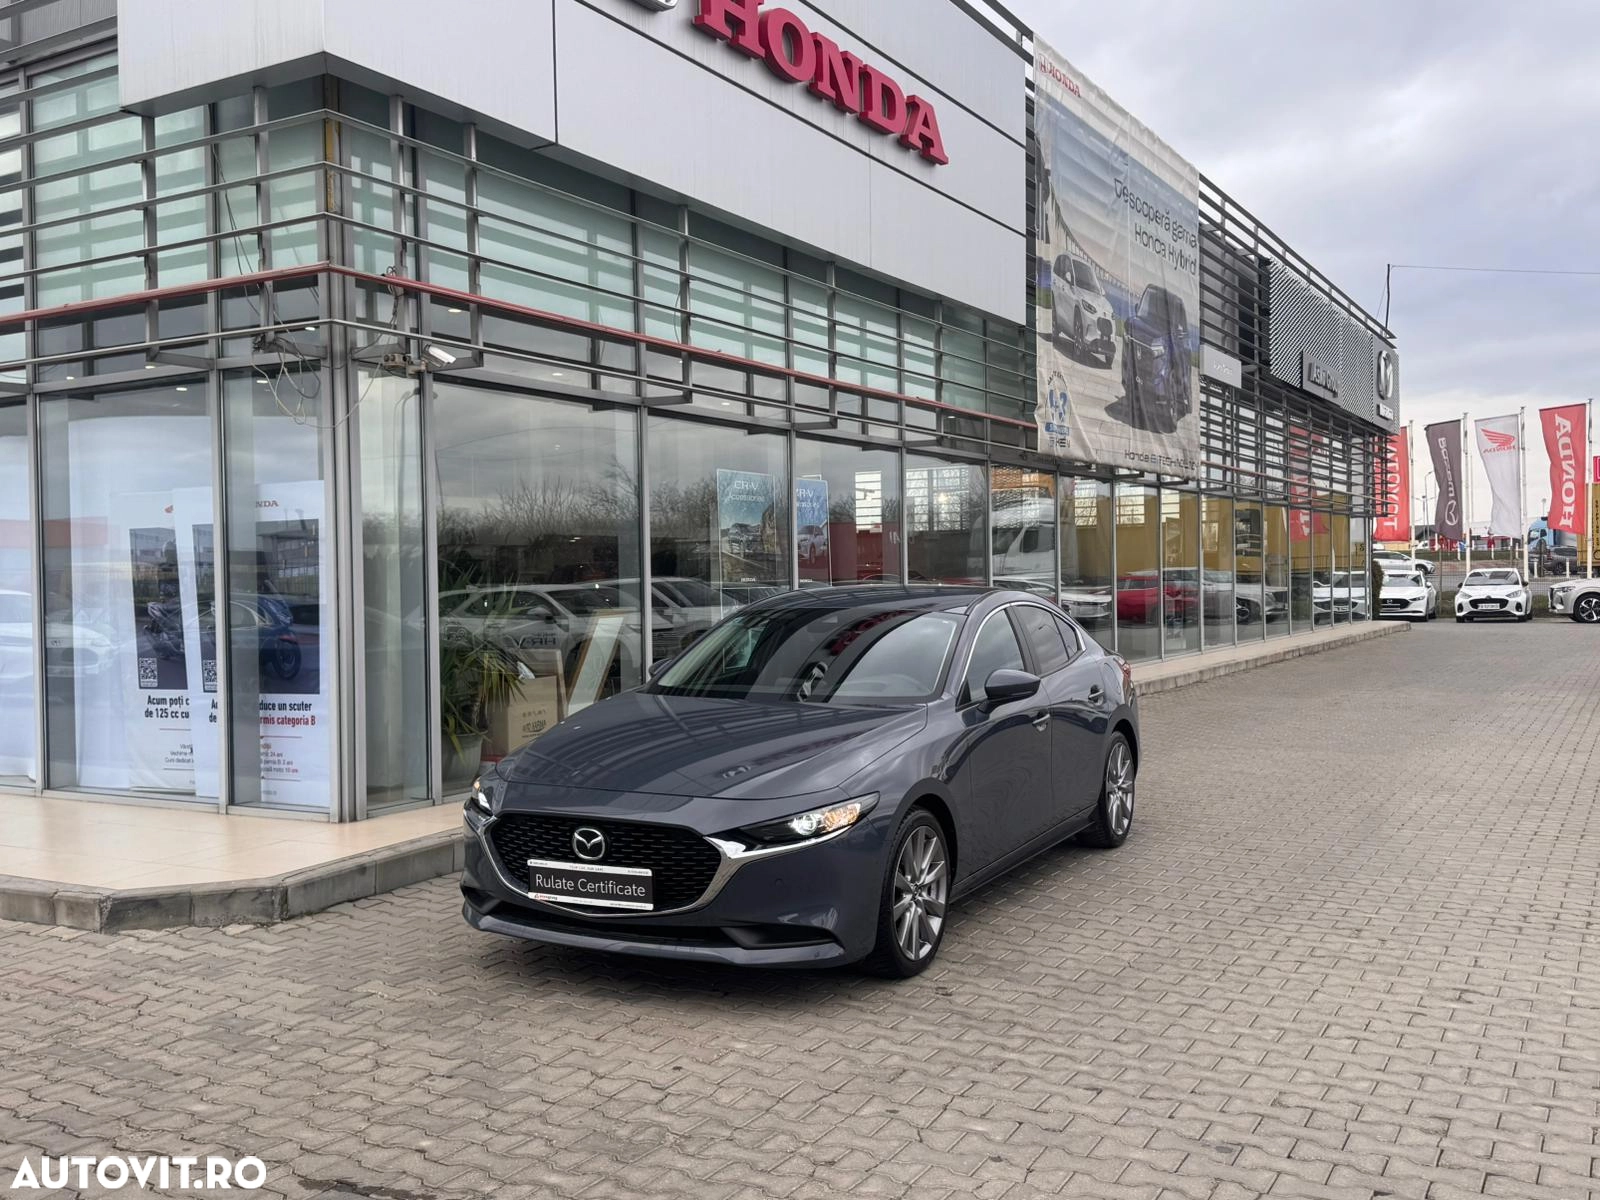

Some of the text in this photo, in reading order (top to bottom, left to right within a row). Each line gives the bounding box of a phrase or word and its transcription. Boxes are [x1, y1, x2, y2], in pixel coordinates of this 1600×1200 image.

[692, 0, 949, 165] HONDA
[1168, 243, 1198, 276] Hybrid
[147, 695, 168, 706] Acum
[259, 699, 312, 711] duce un scuter
[144, 708, 190, 719] de 125 cc cu
[277, 715, 310, 728] categoria
[311, 715, 317, 726] B
[535, 874, 646, 897] Rulate Certificate
